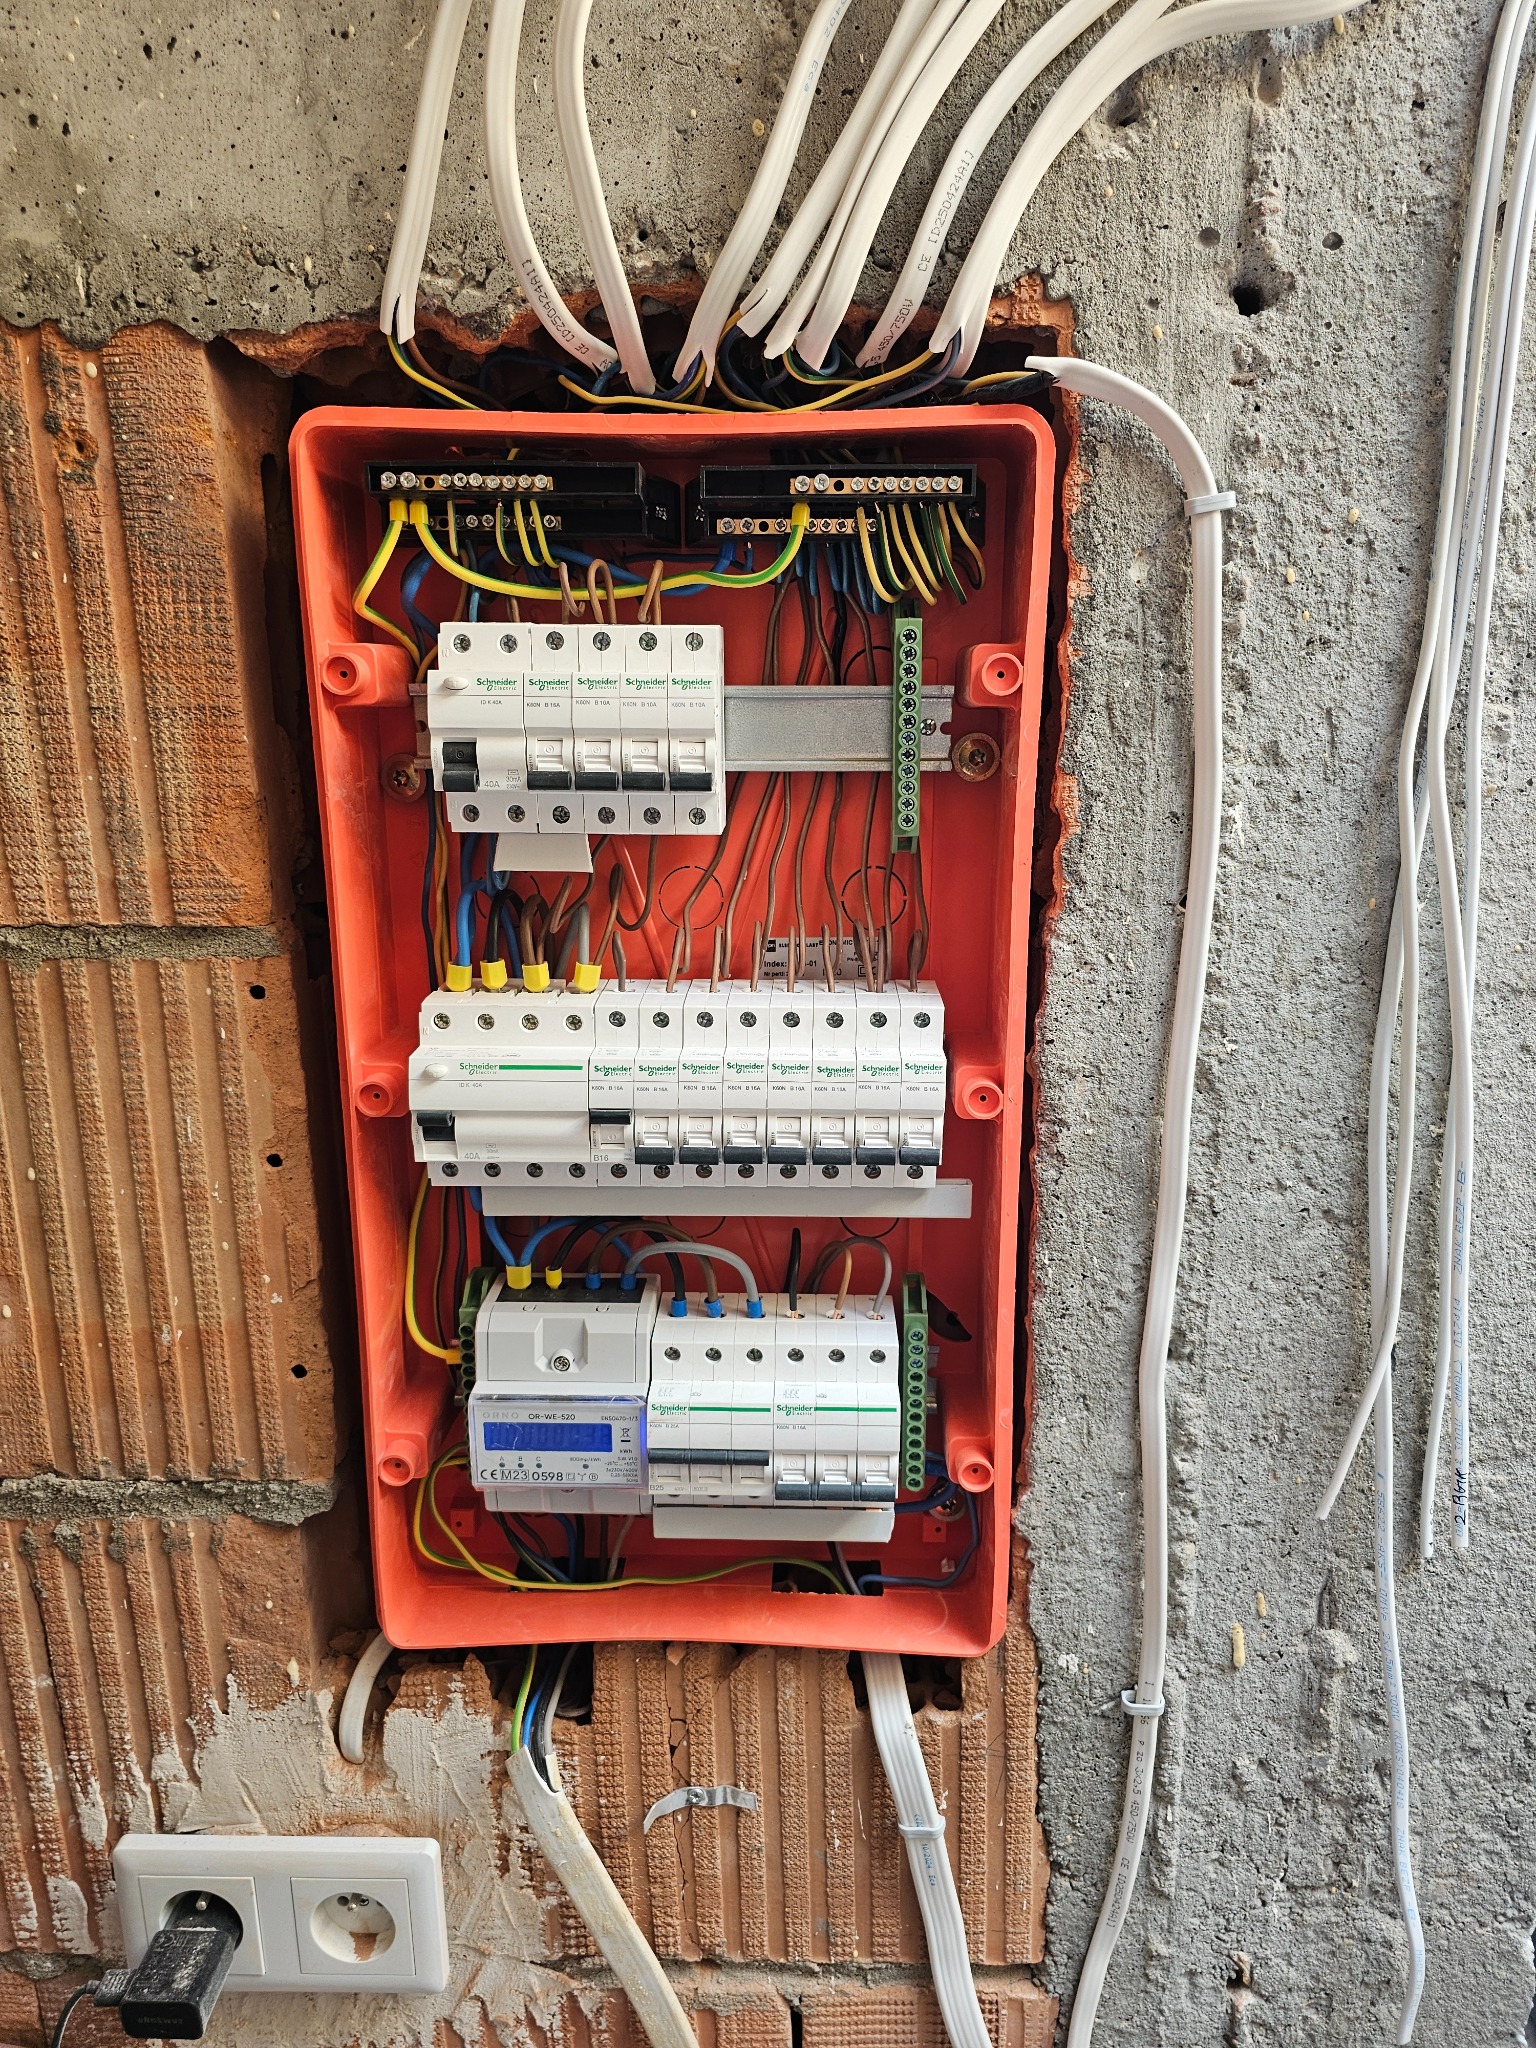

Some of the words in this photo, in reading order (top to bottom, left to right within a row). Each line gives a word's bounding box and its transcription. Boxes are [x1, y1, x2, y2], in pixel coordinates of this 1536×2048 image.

[917, 254, 932, 272] CE
[477, 678, 517, 686] Schneider
[529, 679, 569, 687] Schneider
[577, 677, 618, 686] Schneider
[625, 677, 666, 686] Schneider
[671, 677, 712, 686] Schneider
[682, 1063, 720, 1071] Schneider
[726, 1062, 765, 1070] Schneider
[772, 1063, 810, 1071] Schneider
[904, 1063, 943, 1071] Schneider
[464, 1152, 481, 1160] 40A
[776, 1404, 813, 1412] Schneider
[501, 1470, 528, 1480] M23
[531, 1471, 563, 1481] 0598
[1120, 1857, 1130, 1870] CE
